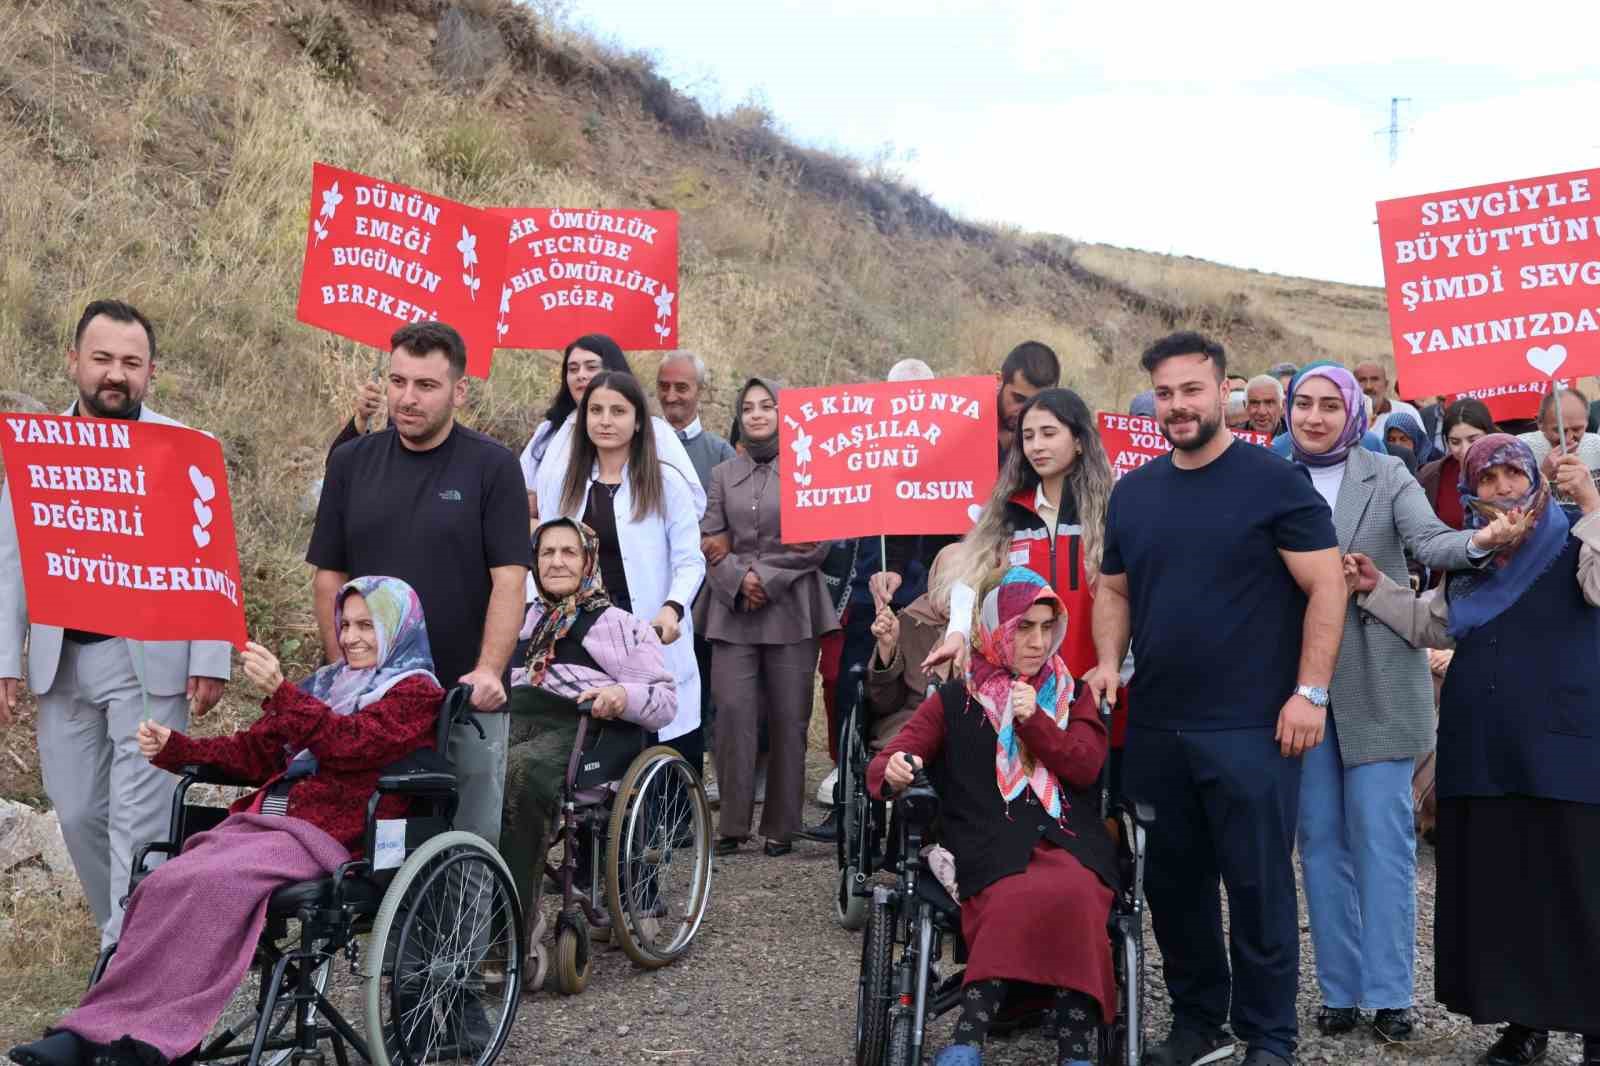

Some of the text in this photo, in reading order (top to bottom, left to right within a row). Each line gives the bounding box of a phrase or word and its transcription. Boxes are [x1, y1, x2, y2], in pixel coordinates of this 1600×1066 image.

[355, 184, 441, 226] DÜNÜN
[1421, 178, 1592, 226] SEVGİYLE
[355, 216, 432, 256] EMEĞİ
[549, 208, 658, 245] ÖMÜRLÜK
[528, 234, 632, 262] TECRÜBE
[332, 247, 442, 293] BUGÜNÜN
[510, 258, 659, 297] BİR ÖMÜRLÜK
[1401, 265, 1505, 312] ŞİMDİ
[540, 285, 615, 312] DEĞER
[1403, 308, 1600, 355] YANINIZDA
[784, 389, 981, 430] 1 EKİM DÜNYA
[6, 418, 131, 449] YARININ
[818, 419, 942, 457] YAŞLILAR
[847, 443, 919, 471] GÜNÜ
[28, 464, 147, 496] REHBERİ
[795, 480, 974, 508] KUTLU OLSUN
[31, 499, 144, 537] DEĞERLİ
[45, 548, 239, 607] BÜYÜKLERİMİZ
